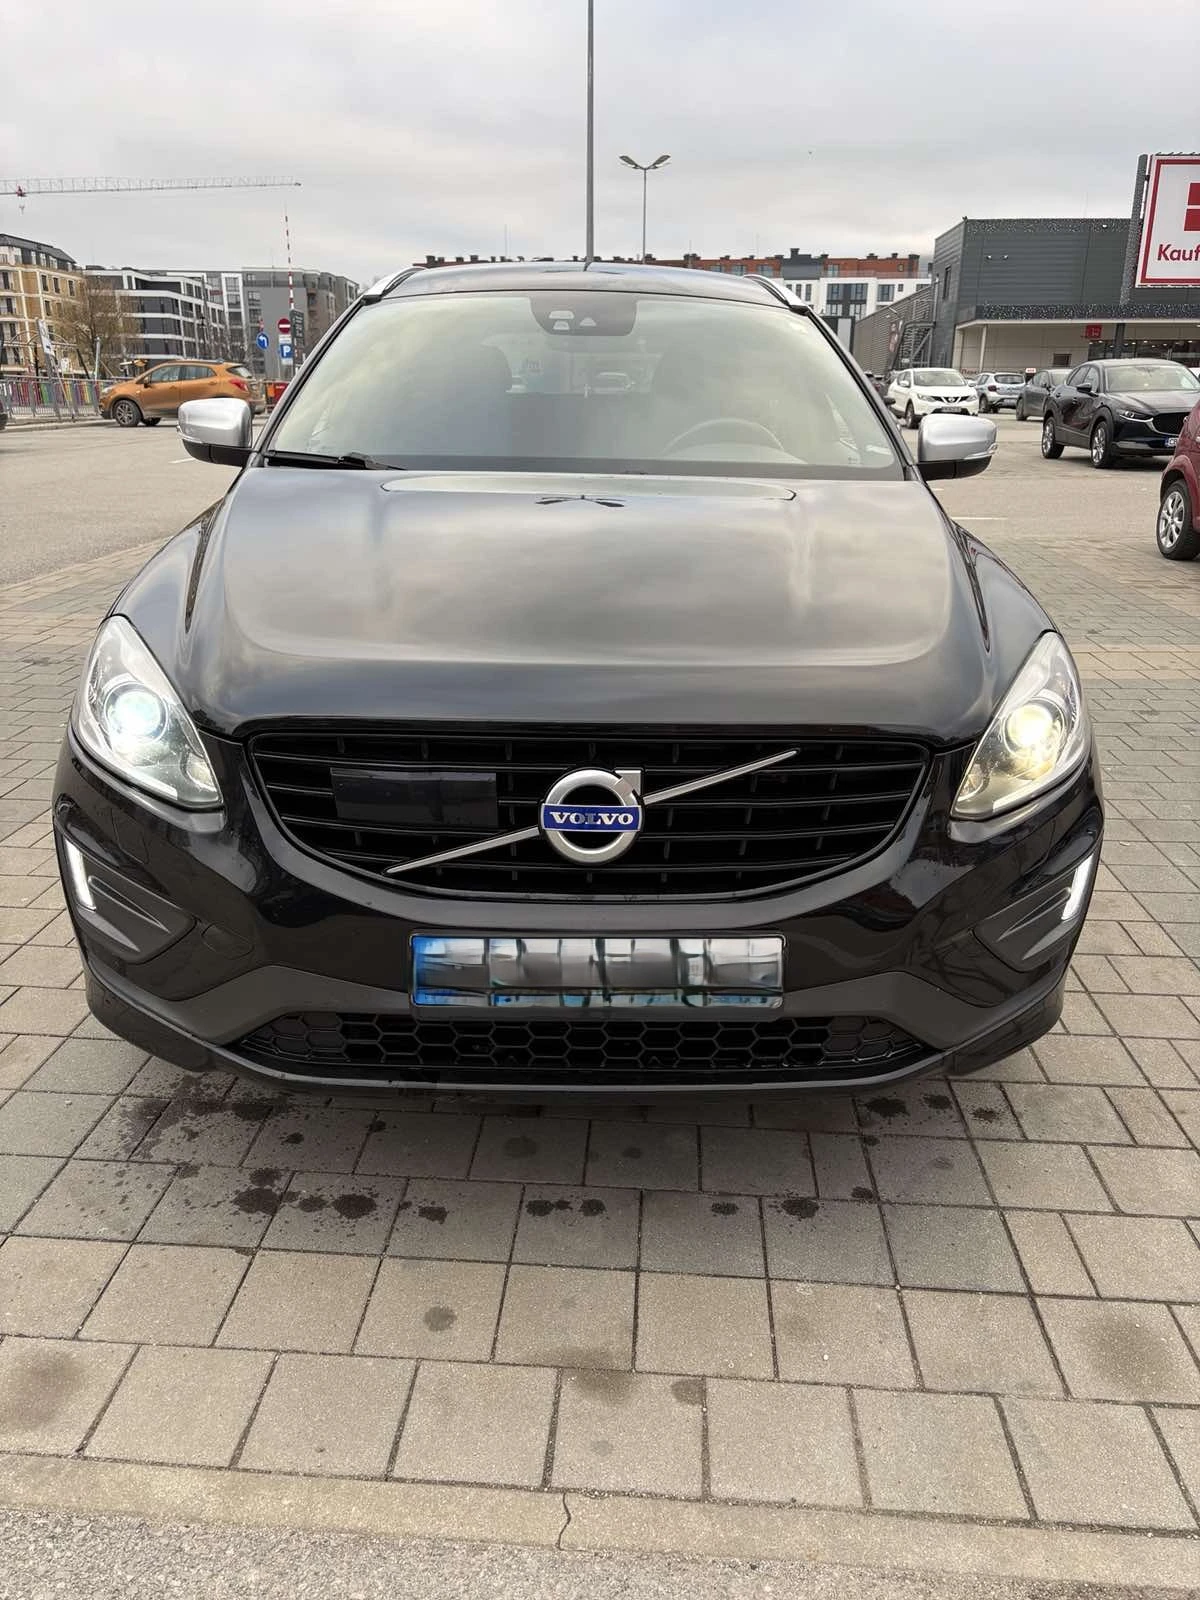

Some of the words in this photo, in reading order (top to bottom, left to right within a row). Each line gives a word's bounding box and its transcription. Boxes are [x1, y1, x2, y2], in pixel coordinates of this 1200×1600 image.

[1157, 243, 1200, 261] Kauf
[283, 345, 291, 357] P
[550, 812, 634, 825] VOLVO
